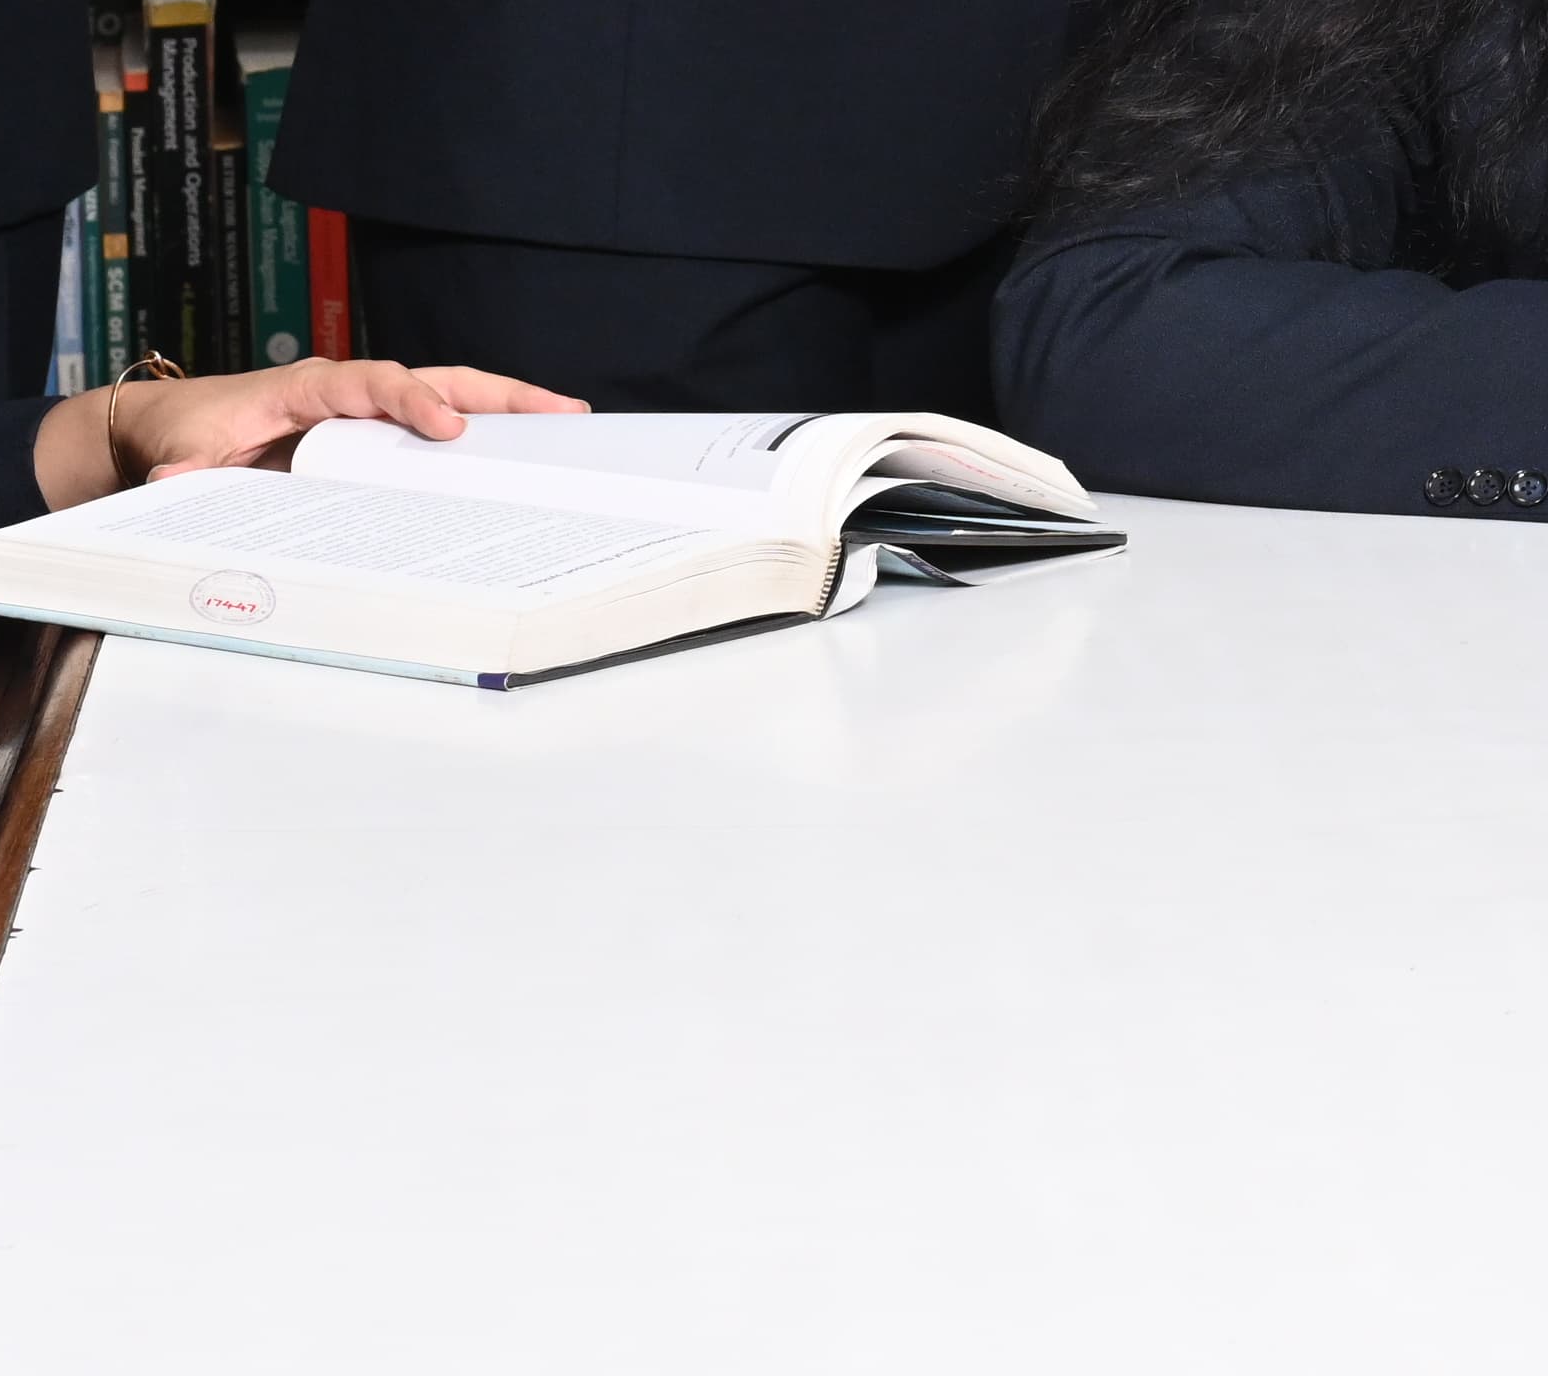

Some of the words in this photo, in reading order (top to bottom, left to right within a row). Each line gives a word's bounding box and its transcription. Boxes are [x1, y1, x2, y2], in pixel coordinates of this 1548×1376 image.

[181, 38, 199, 130] Production
[184, 136, 199, 166] and
[182, 173, 202, 266] Operations
